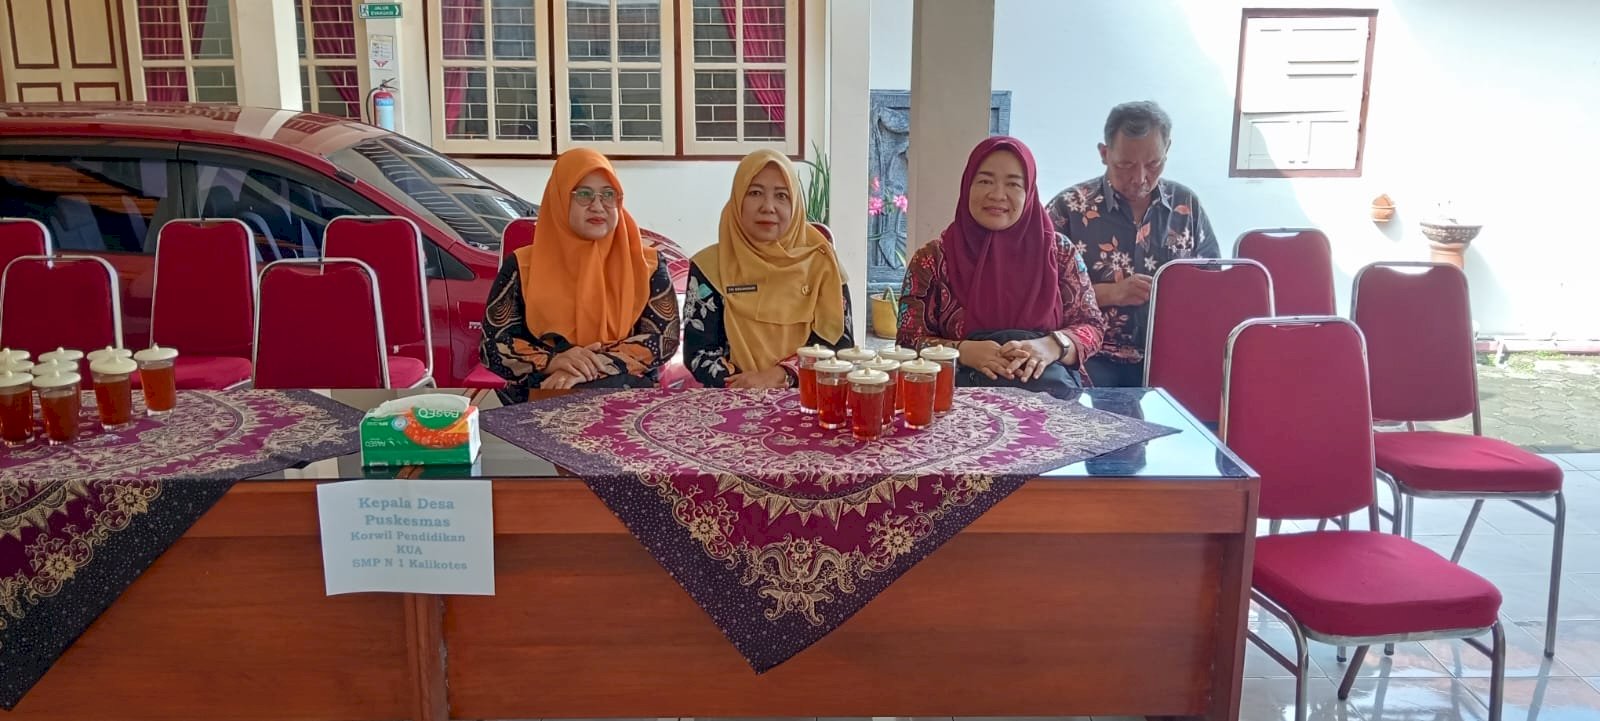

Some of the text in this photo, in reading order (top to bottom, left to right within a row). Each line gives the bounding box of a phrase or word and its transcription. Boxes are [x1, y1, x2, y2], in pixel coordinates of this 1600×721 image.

[358, 498, 454, 511] Kepala Desa
[365, 514, 450, 527] Puskesmas
[351, 531, 466, 542] Korwil Pendidikan
[396, 545, 422, 555] KUA
[352, 558, 468, 570] SMP N 1 Kalikotes
